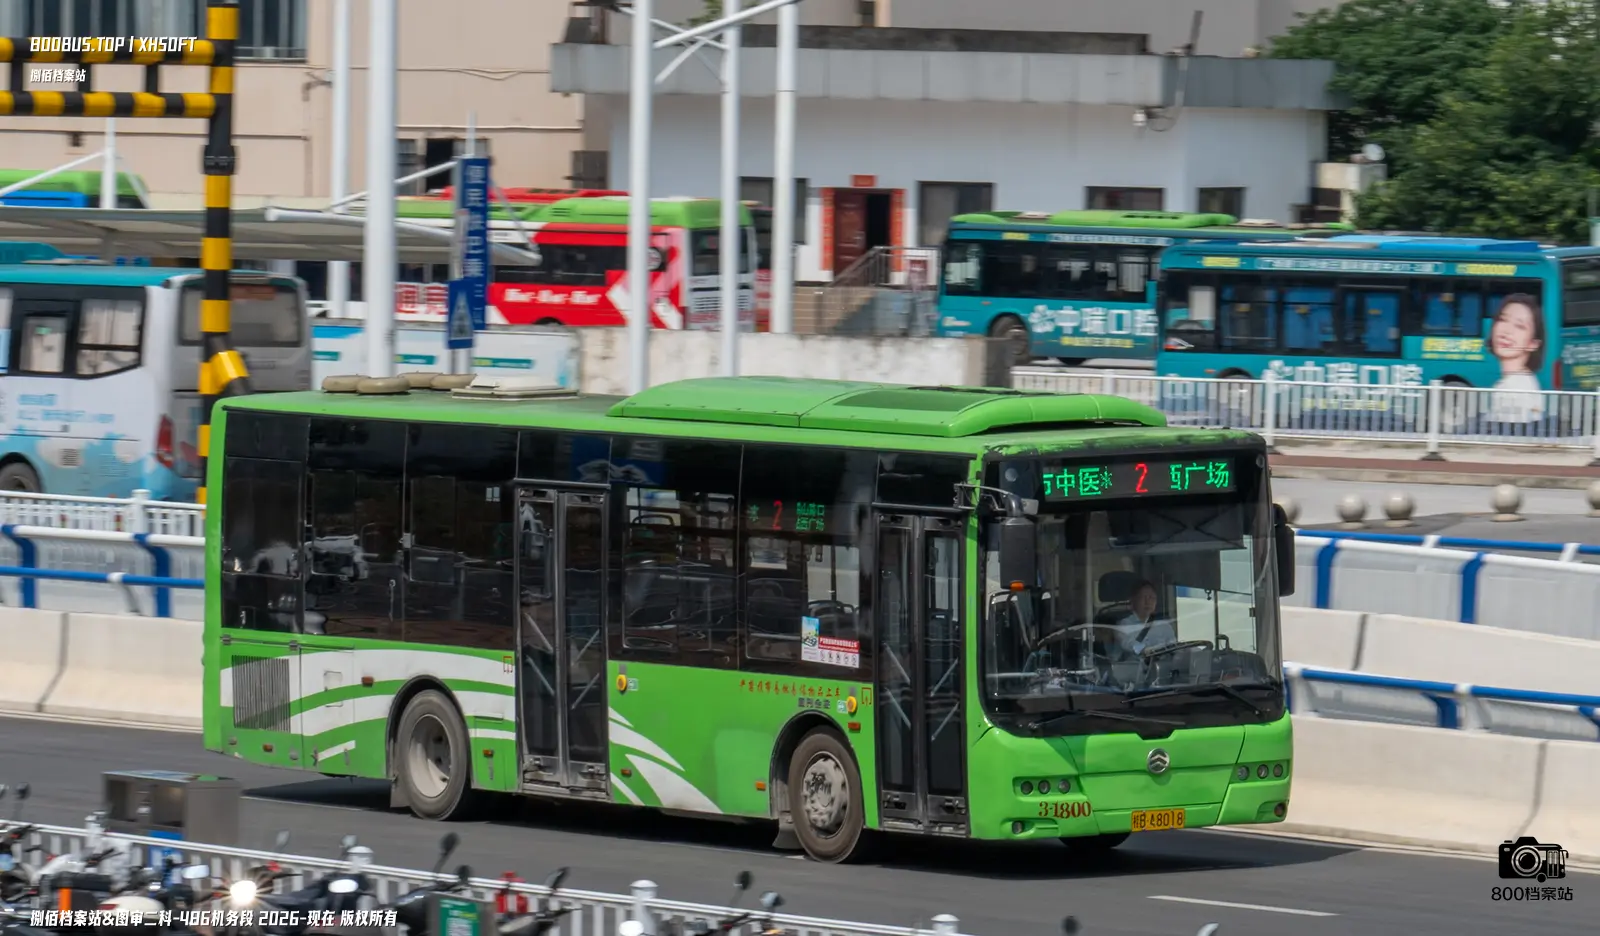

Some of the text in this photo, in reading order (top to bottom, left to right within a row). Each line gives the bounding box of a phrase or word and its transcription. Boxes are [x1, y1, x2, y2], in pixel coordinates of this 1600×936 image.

[1135, 463, 1148, 492] 2
[772, 500, 783, 531] 2
[1038, 801, 1092, 819] 3-1800
